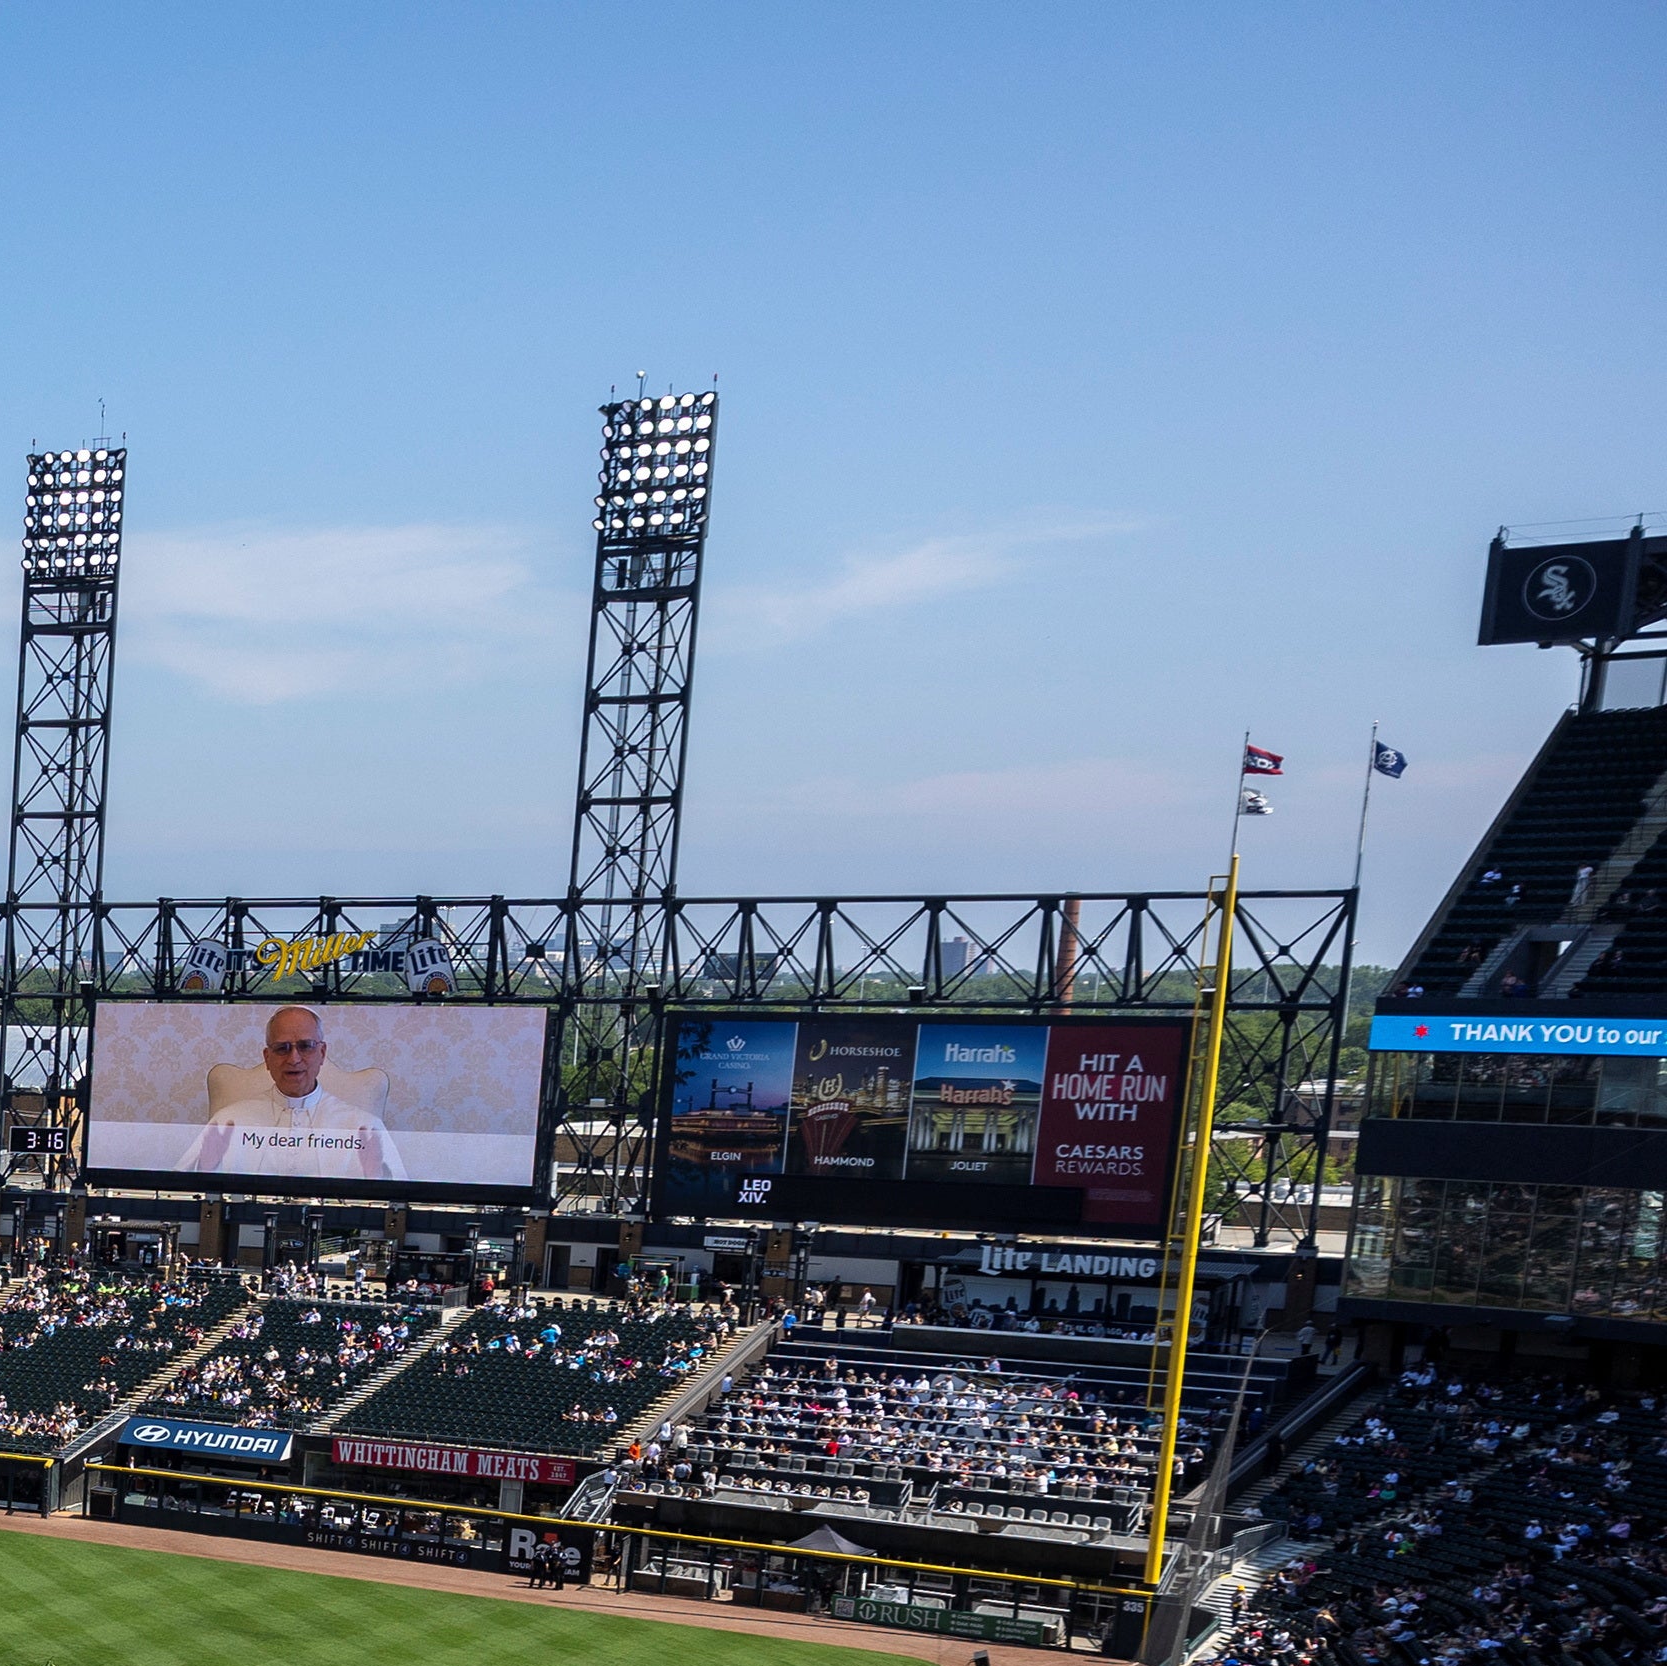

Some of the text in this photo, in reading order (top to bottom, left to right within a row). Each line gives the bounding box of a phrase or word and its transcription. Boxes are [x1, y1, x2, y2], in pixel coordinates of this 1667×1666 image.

[188, 947, 224, 972] Lite
[256, 930, 377, 982] Miller
[350, 950, 405, 973] TIME
[409, 946, 447, 976] Lite
[1450, 1024, 1662, 1045] THANK YOU to our
[1079, 1054, 1144, 1072] HIT A
[1052, 1073, 1166, 1102] HOME RUN
[1074, 1102, 1137, 1121] WITH
[27, 1132, 64, 1149] 3:16
[242, 1132, 366, 1152] My dear friends.
[711, 1151, 741, 1161] ELGIN
[814, 1155, 875, 1167] HAMMOND
[1055, 1144, 1144, 1159] CAESARS
[950, 1161, 988, 1172] JOLIET
[743, 1180, 771, 1191] LEO
[738, 1191, 766, 1204] XIV.
[978, 1244, 1157, 1278] Lite LANDING
[173, 1429, 279, 1455] HYUNDAI
[338, 1440, 540, 1480] WHITTINGHAM MEATS
[879, 1605, 941, 1629] RUSH
[1123, 1601, 1144, 1614] 335
